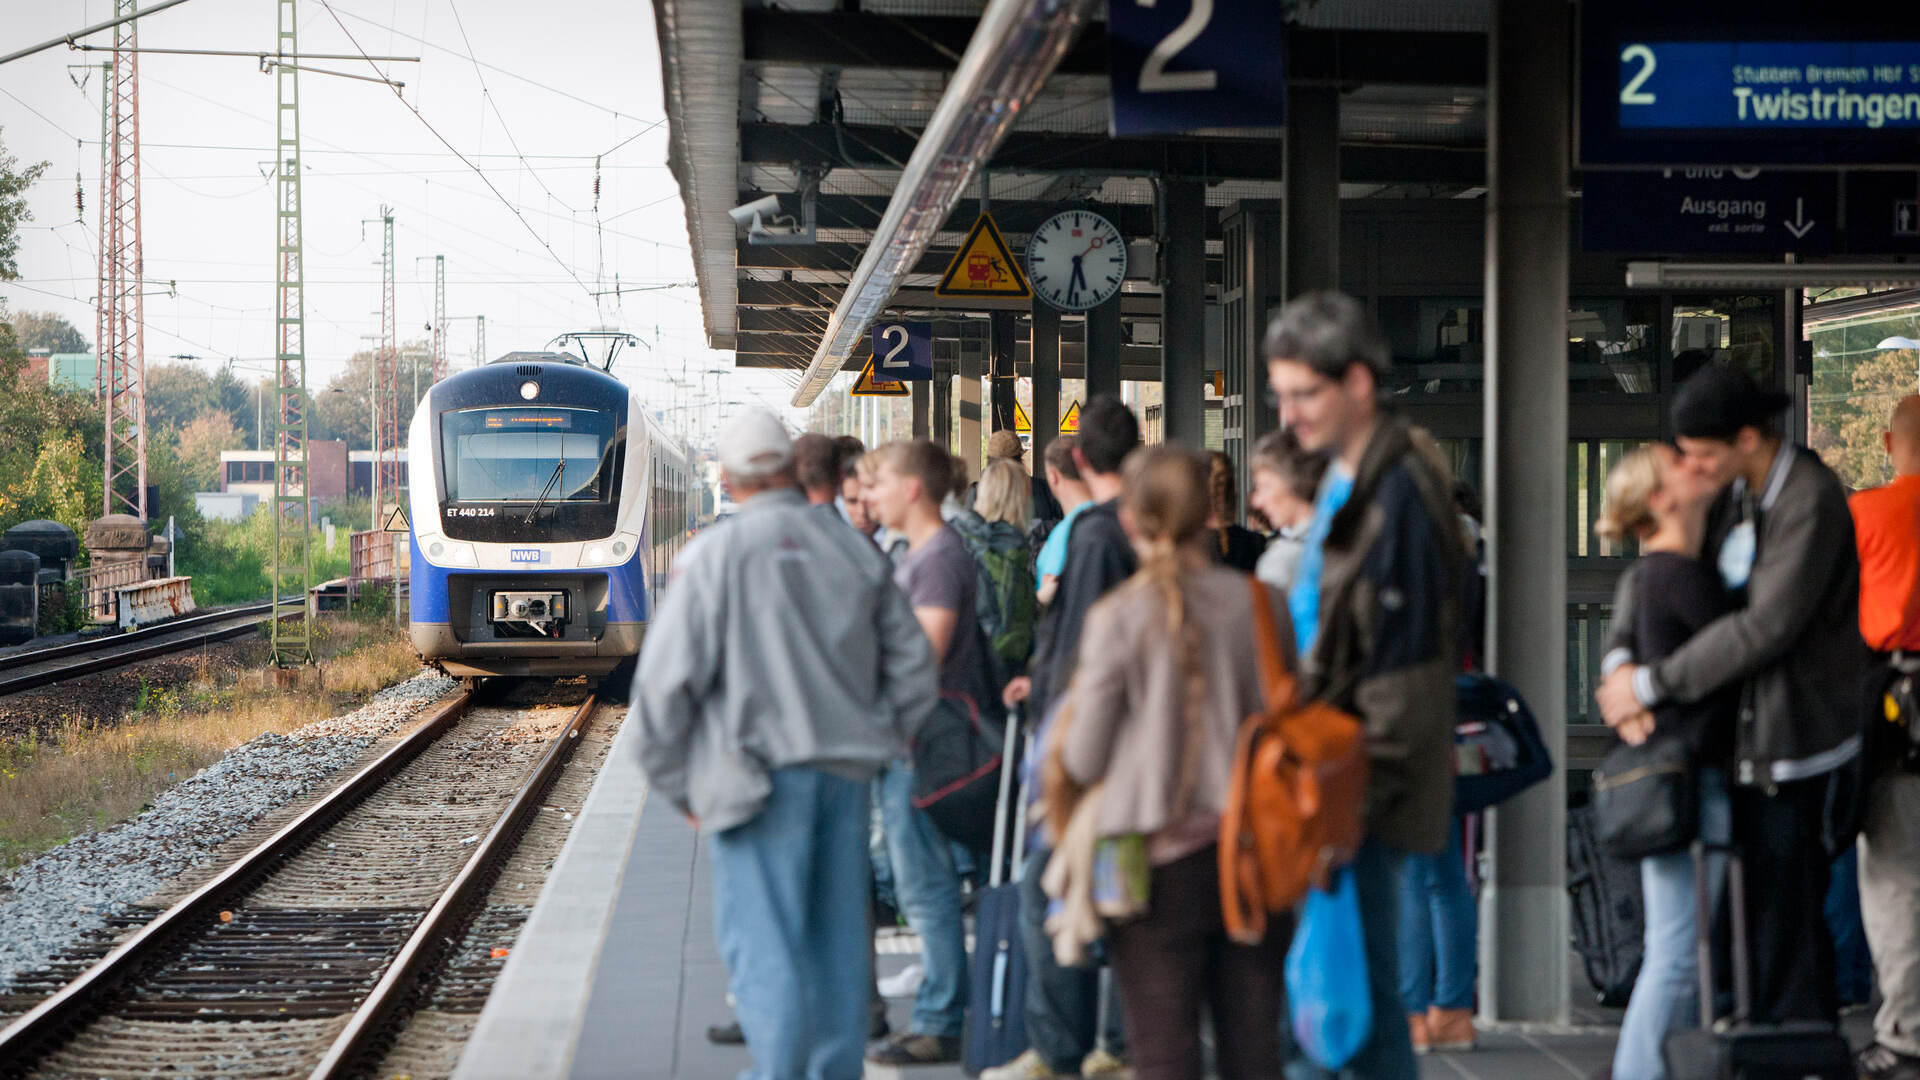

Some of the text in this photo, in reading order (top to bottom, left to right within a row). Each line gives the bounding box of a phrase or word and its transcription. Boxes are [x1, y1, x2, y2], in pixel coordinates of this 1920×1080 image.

[1138, 0, 1217, 92] 2
[1620, 44, 1657, 105] 2
[1806, 64, 1869, 84] Bremen
[1873, 65, 1903, 83] Hbf
[1732, 86, 1920, 128] Twistringen
[1681, 196, 1766, 219] Ausgang
[881, 325, 910, 369] 2
[447, 508, 495, 517] ET 440 214
[511, 550, 540, 561] NWB
